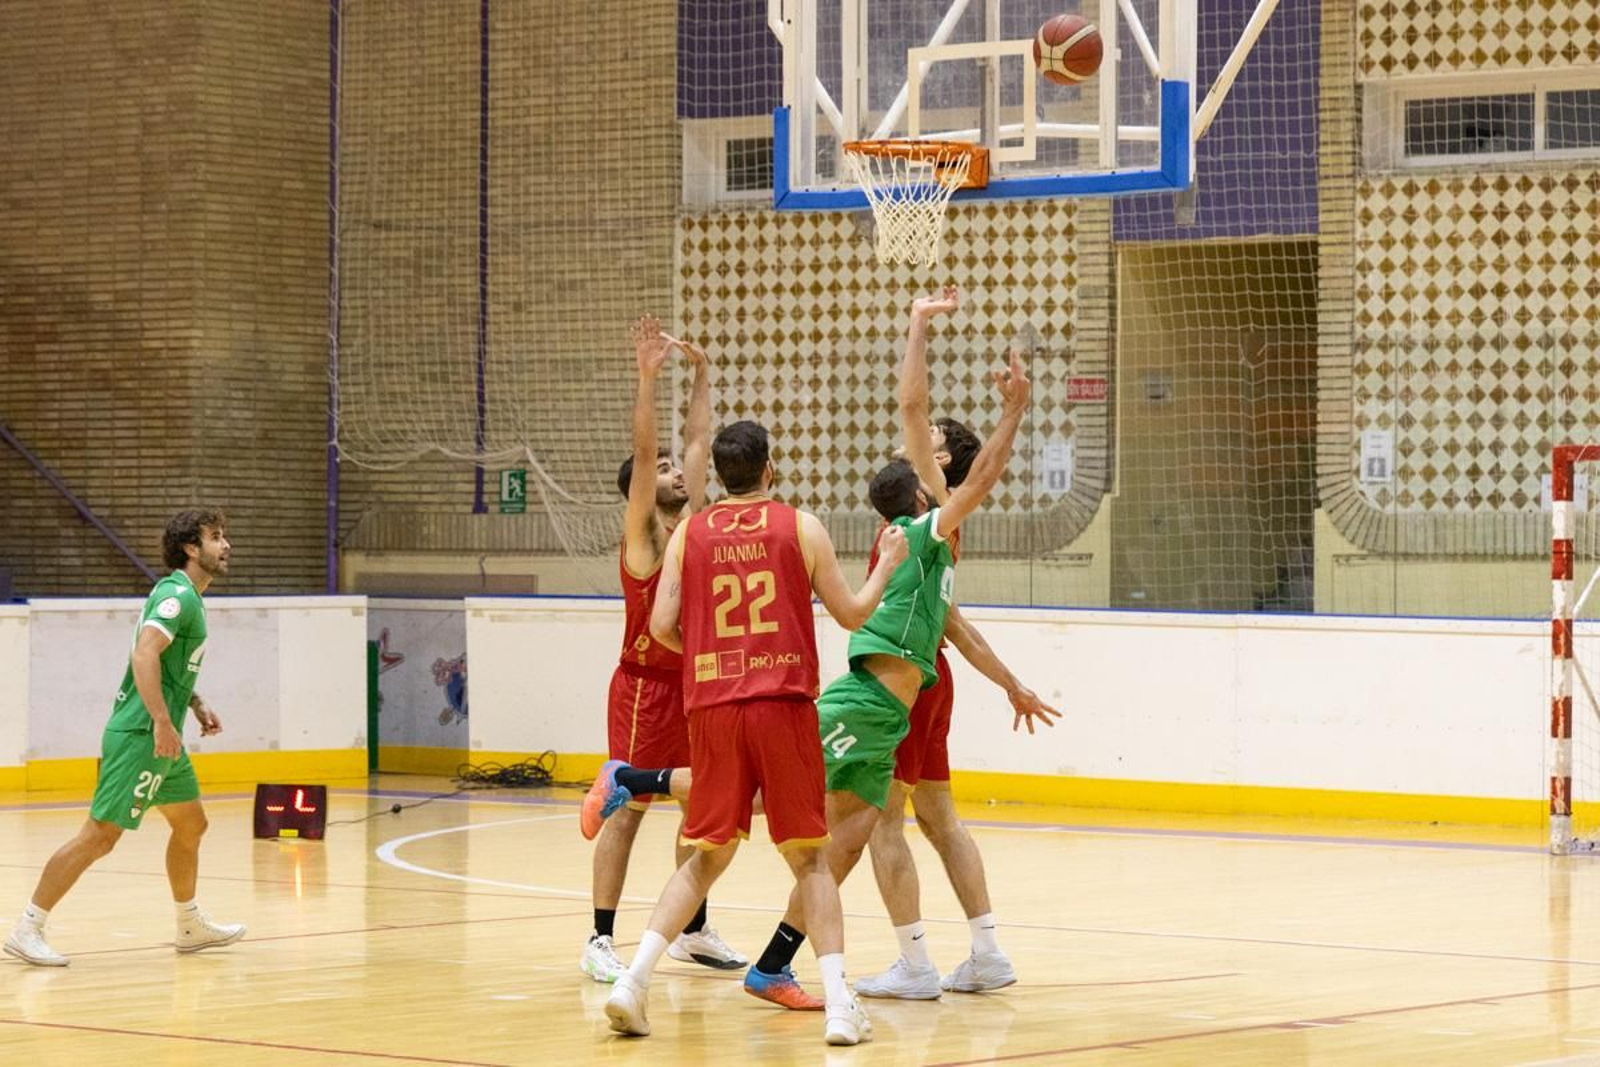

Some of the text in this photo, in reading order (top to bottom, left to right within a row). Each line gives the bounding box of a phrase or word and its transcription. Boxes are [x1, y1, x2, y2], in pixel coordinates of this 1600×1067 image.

[712, 542, 768, 565] JUANMA
[712, 570, 778, 638] 22
[821, 722, 857, 759] 14
[134, 771, 162, 800] 20
